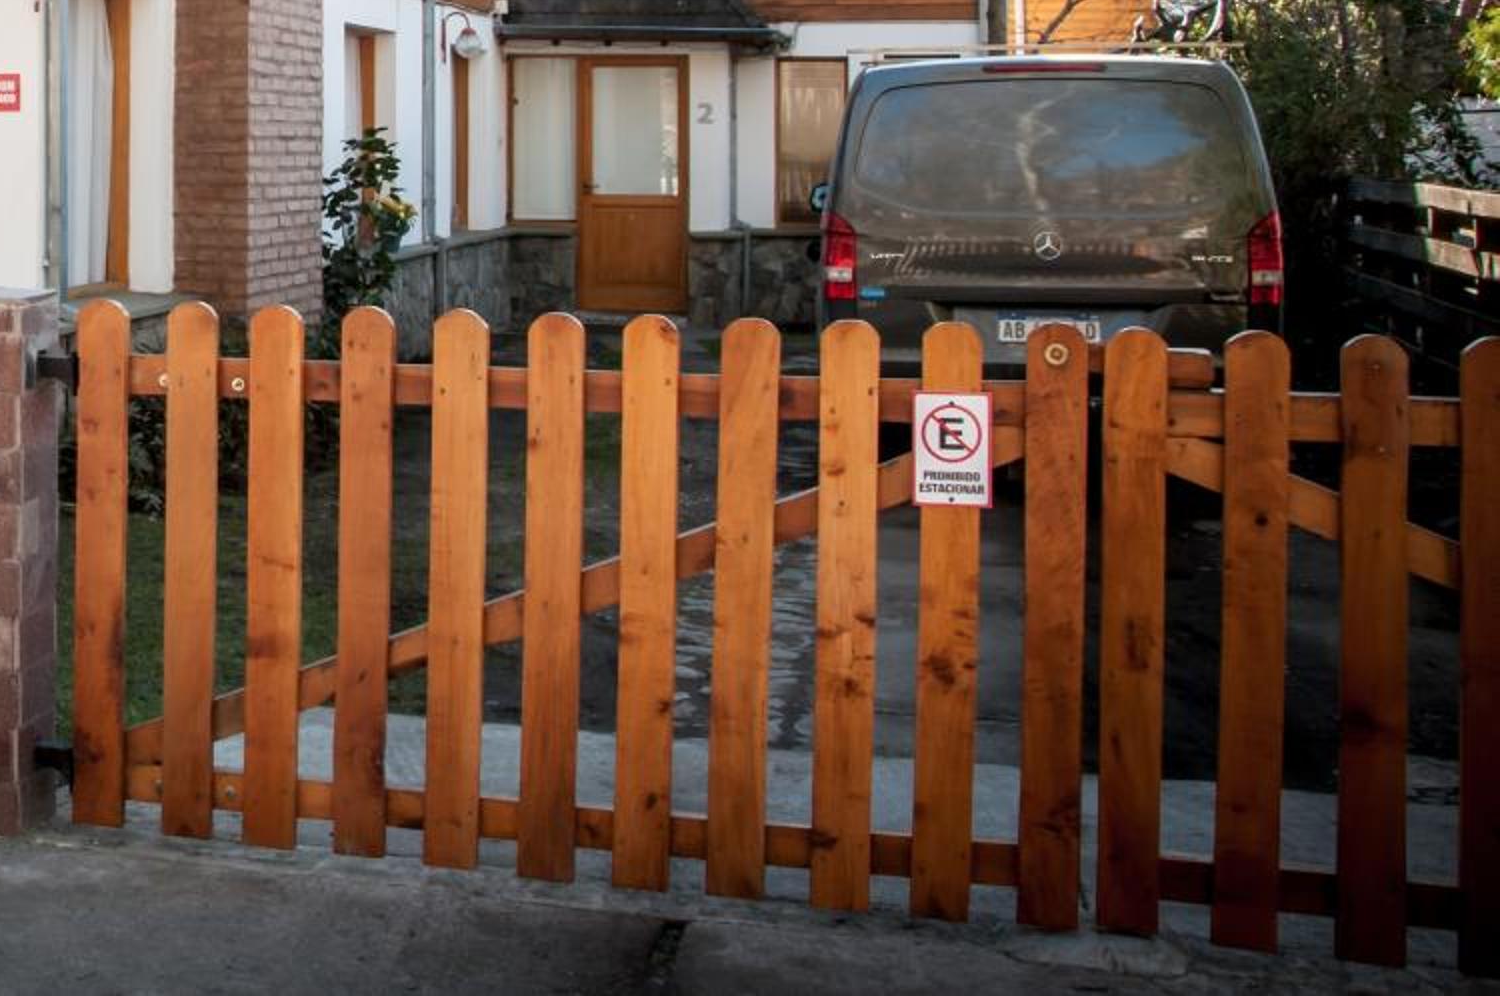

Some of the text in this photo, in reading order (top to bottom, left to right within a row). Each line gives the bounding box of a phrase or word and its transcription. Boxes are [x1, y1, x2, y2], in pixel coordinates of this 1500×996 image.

[697, 103, 715, 124] 2
[1002, 321, 1026, 340] AB
[940, 418, 965, 450] E
[924, 471, 981, 481] PROHIBIDO
[920, 484, 985, 495] ESTACIONAR
